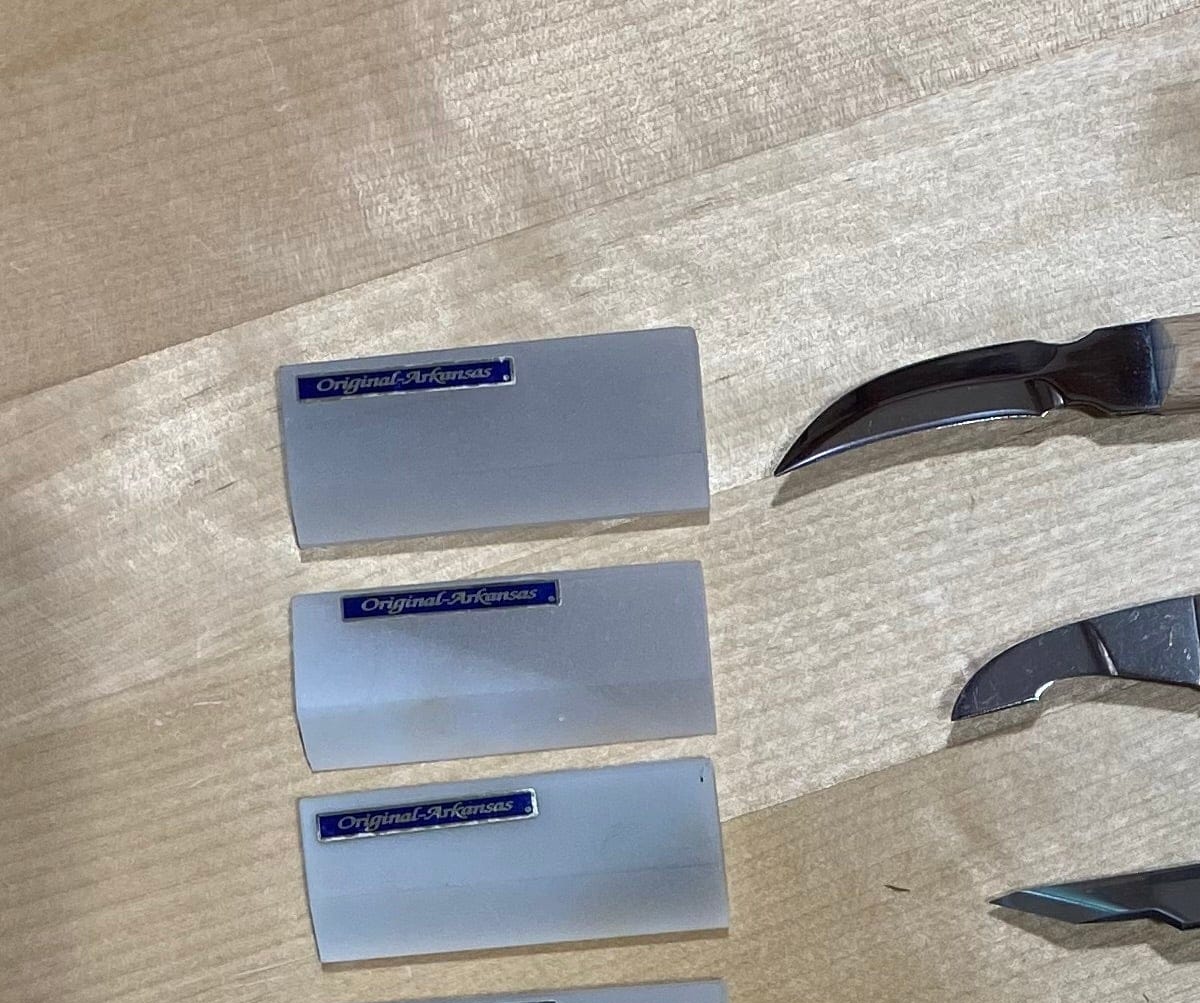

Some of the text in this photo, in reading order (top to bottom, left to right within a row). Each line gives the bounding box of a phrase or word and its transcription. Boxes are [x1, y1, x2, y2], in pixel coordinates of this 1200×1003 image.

[316, 366, 492, 394] Original-Arkansas
[361, 586, 538, 614] Original-Arkansas
[338, 799, 514, 832] Original-Arkansas
